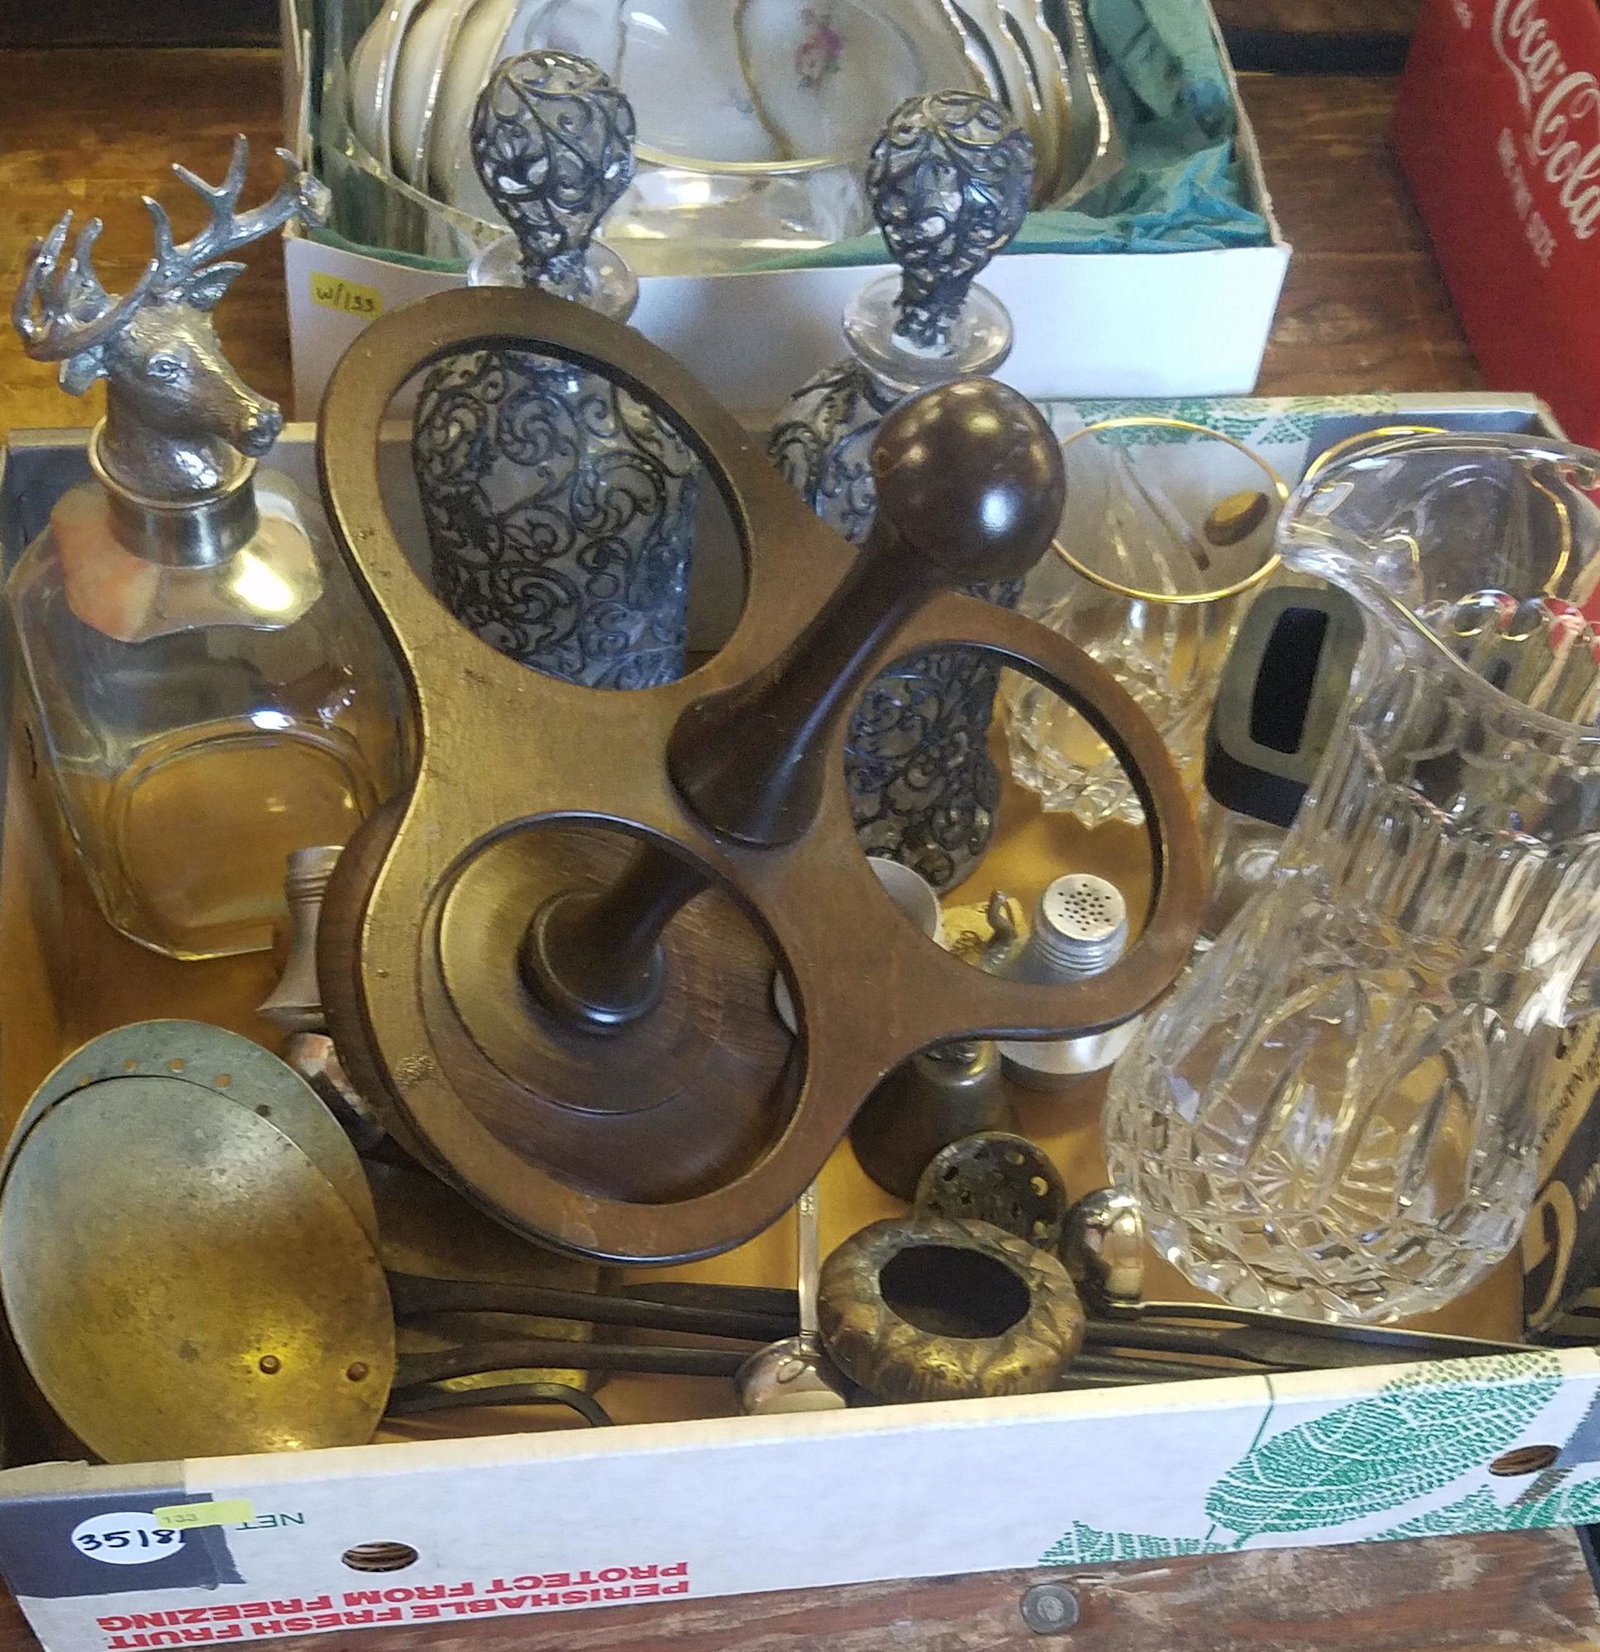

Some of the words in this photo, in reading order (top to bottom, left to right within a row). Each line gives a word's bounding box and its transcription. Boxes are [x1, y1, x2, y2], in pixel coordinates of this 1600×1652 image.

[235, 1512, 305, 1531] NET
[485, 1562, 688, 1595] PROTECT
[342, 1582, 475, 1608] FROM
[412, 1581, 690, 1619] PERISHABLE
[95, 1595, 332, 1631] FREEZING
[251, 1606, 403, 1636] FRESH
[107, 1624, 244, 1650] FRUIT
